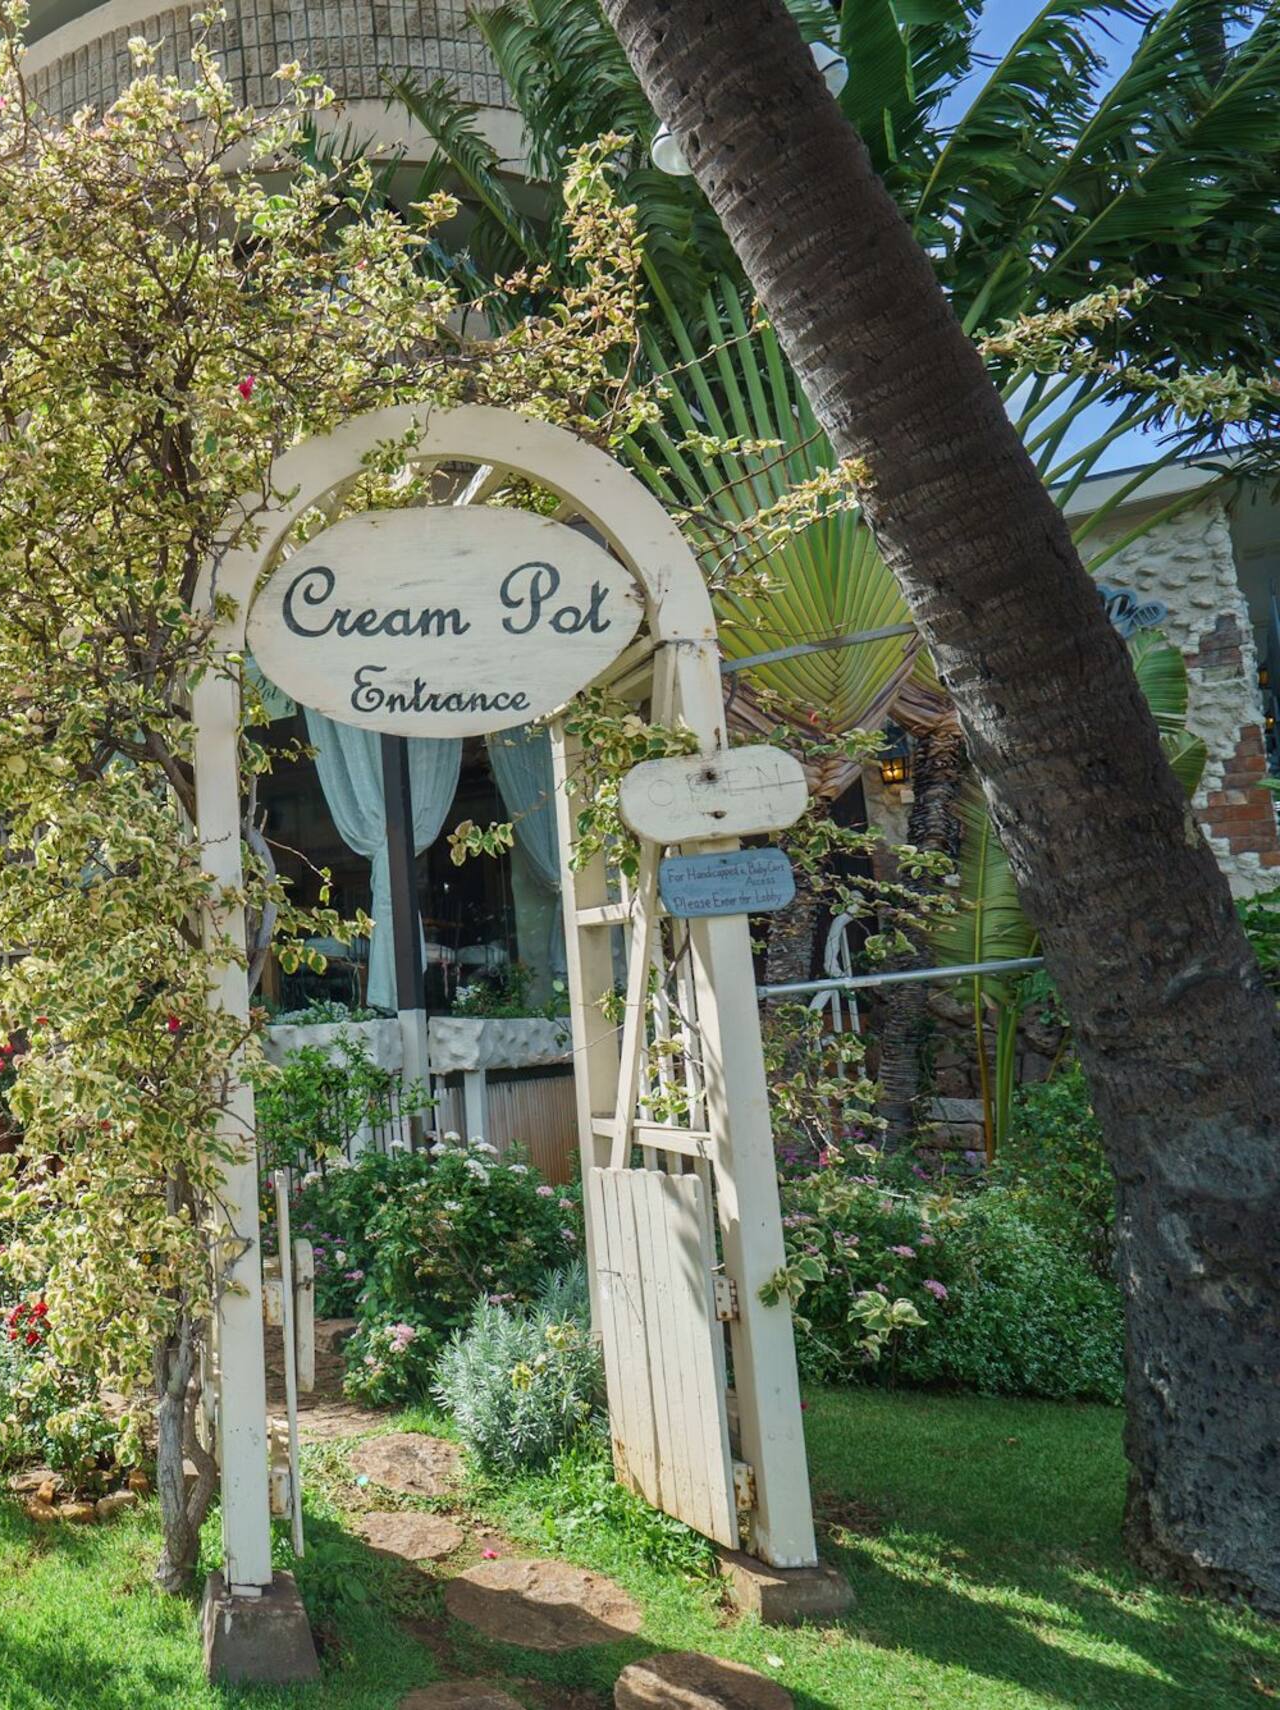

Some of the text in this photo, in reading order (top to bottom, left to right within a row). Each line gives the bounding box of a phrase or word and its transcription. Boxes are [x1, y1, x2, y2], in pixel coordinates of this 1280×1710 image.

[282, 560, 612, 638] Cream Pot
[350, 664, 531, 714] Entrance
[647, 762, 784, 808] OPEN
[666, 867, 684, 883] For
[672, 895, 711, 914] Please
[754, 887, 783, 906] Lobby
